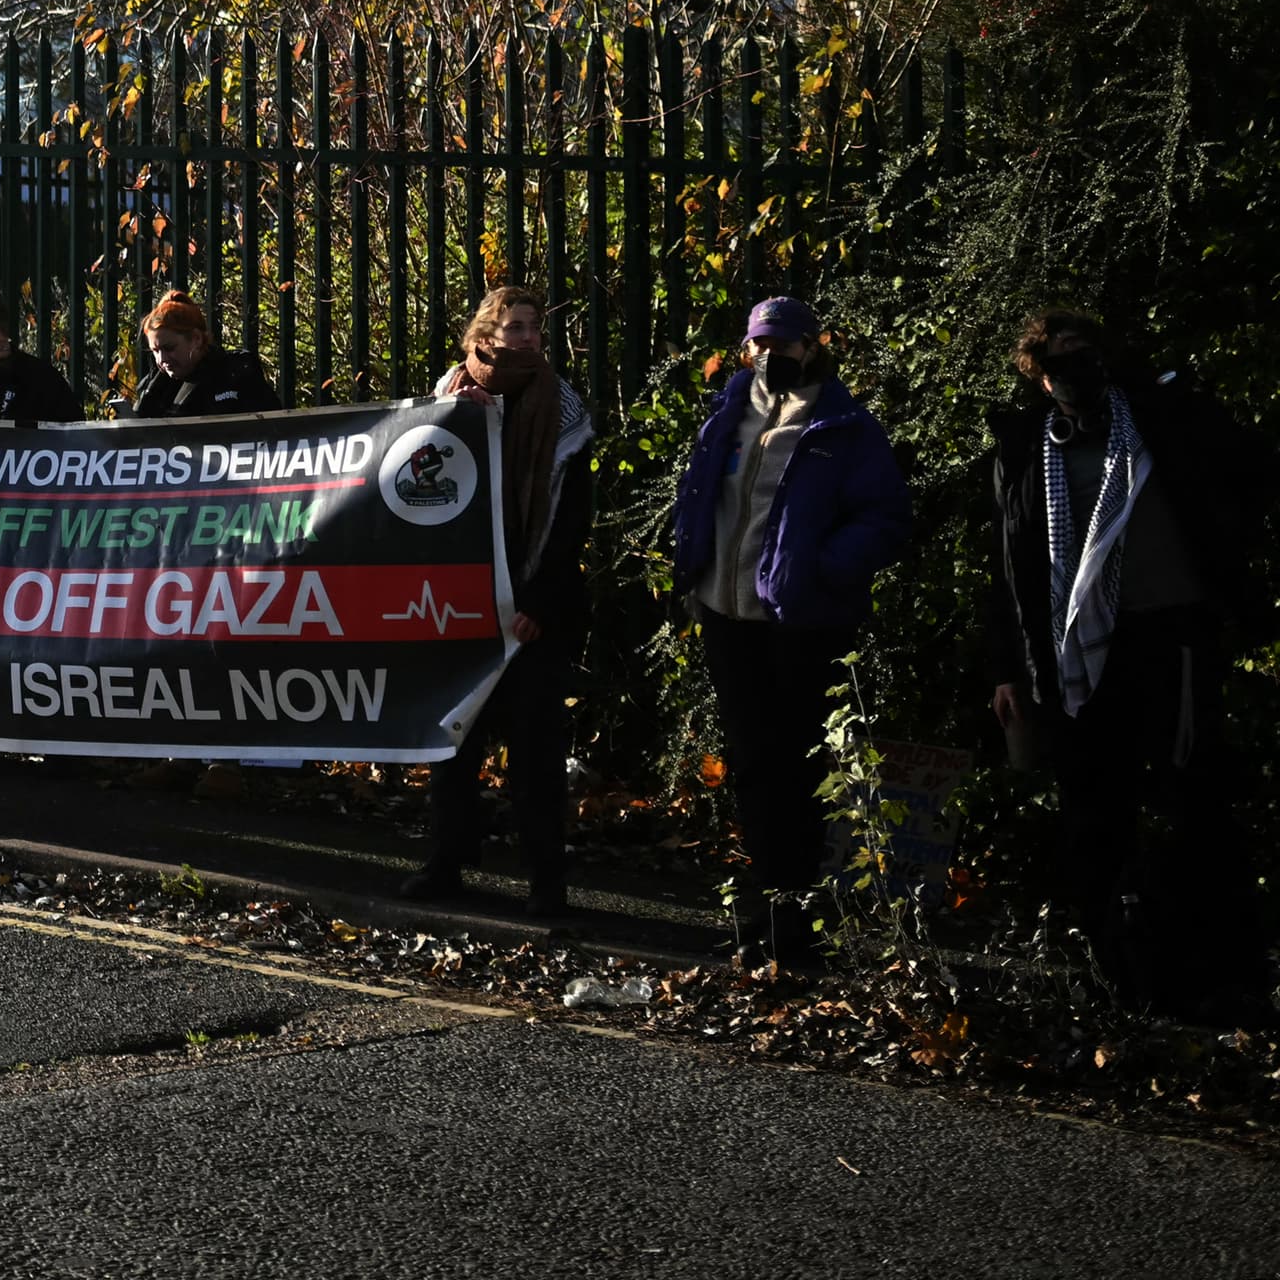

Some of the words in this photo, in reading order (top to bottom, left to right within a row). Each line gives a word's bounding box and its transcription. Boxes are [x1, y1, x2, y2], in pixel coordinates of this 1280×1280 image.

[201, 433, 374, 482] DEMAND
[60, 504, 189, 549] WEST
[191, 498, 319, 546] BANK
[3, 570, 136, 634] OFF
[145, 570, 344, 638] GAZA
[12, 665, 220, 721] ISREAL
[229, 667, 386, 721] NOW
